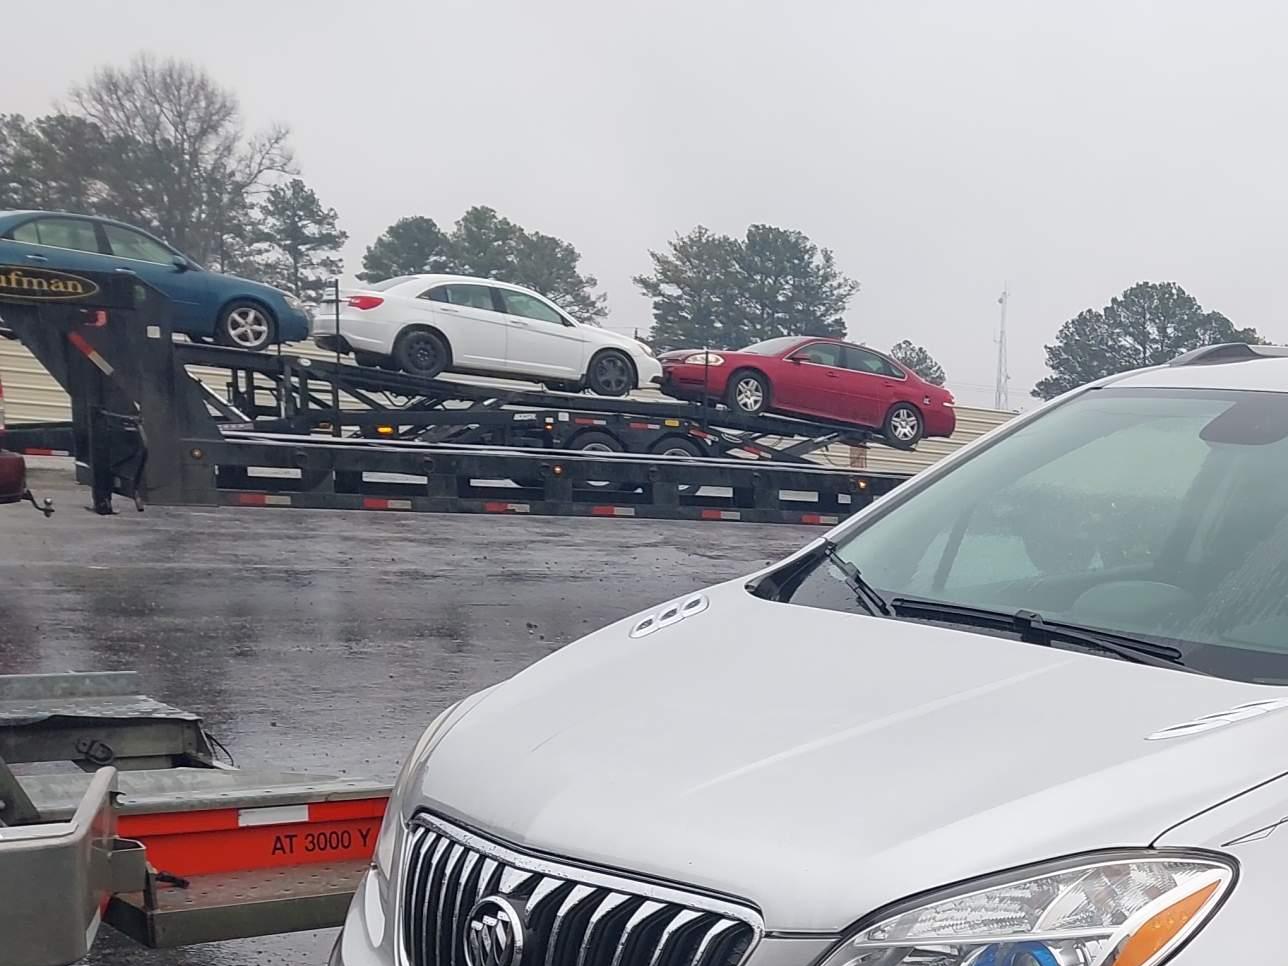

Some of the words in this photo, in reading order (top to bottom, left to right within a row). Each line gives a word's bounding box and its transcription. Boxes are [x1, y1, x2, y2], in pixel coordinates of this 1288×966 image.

[271, 834, 298, 856] AT
[304, 830, 352, 852] 3000
[358, 827, 372, 848] Y
